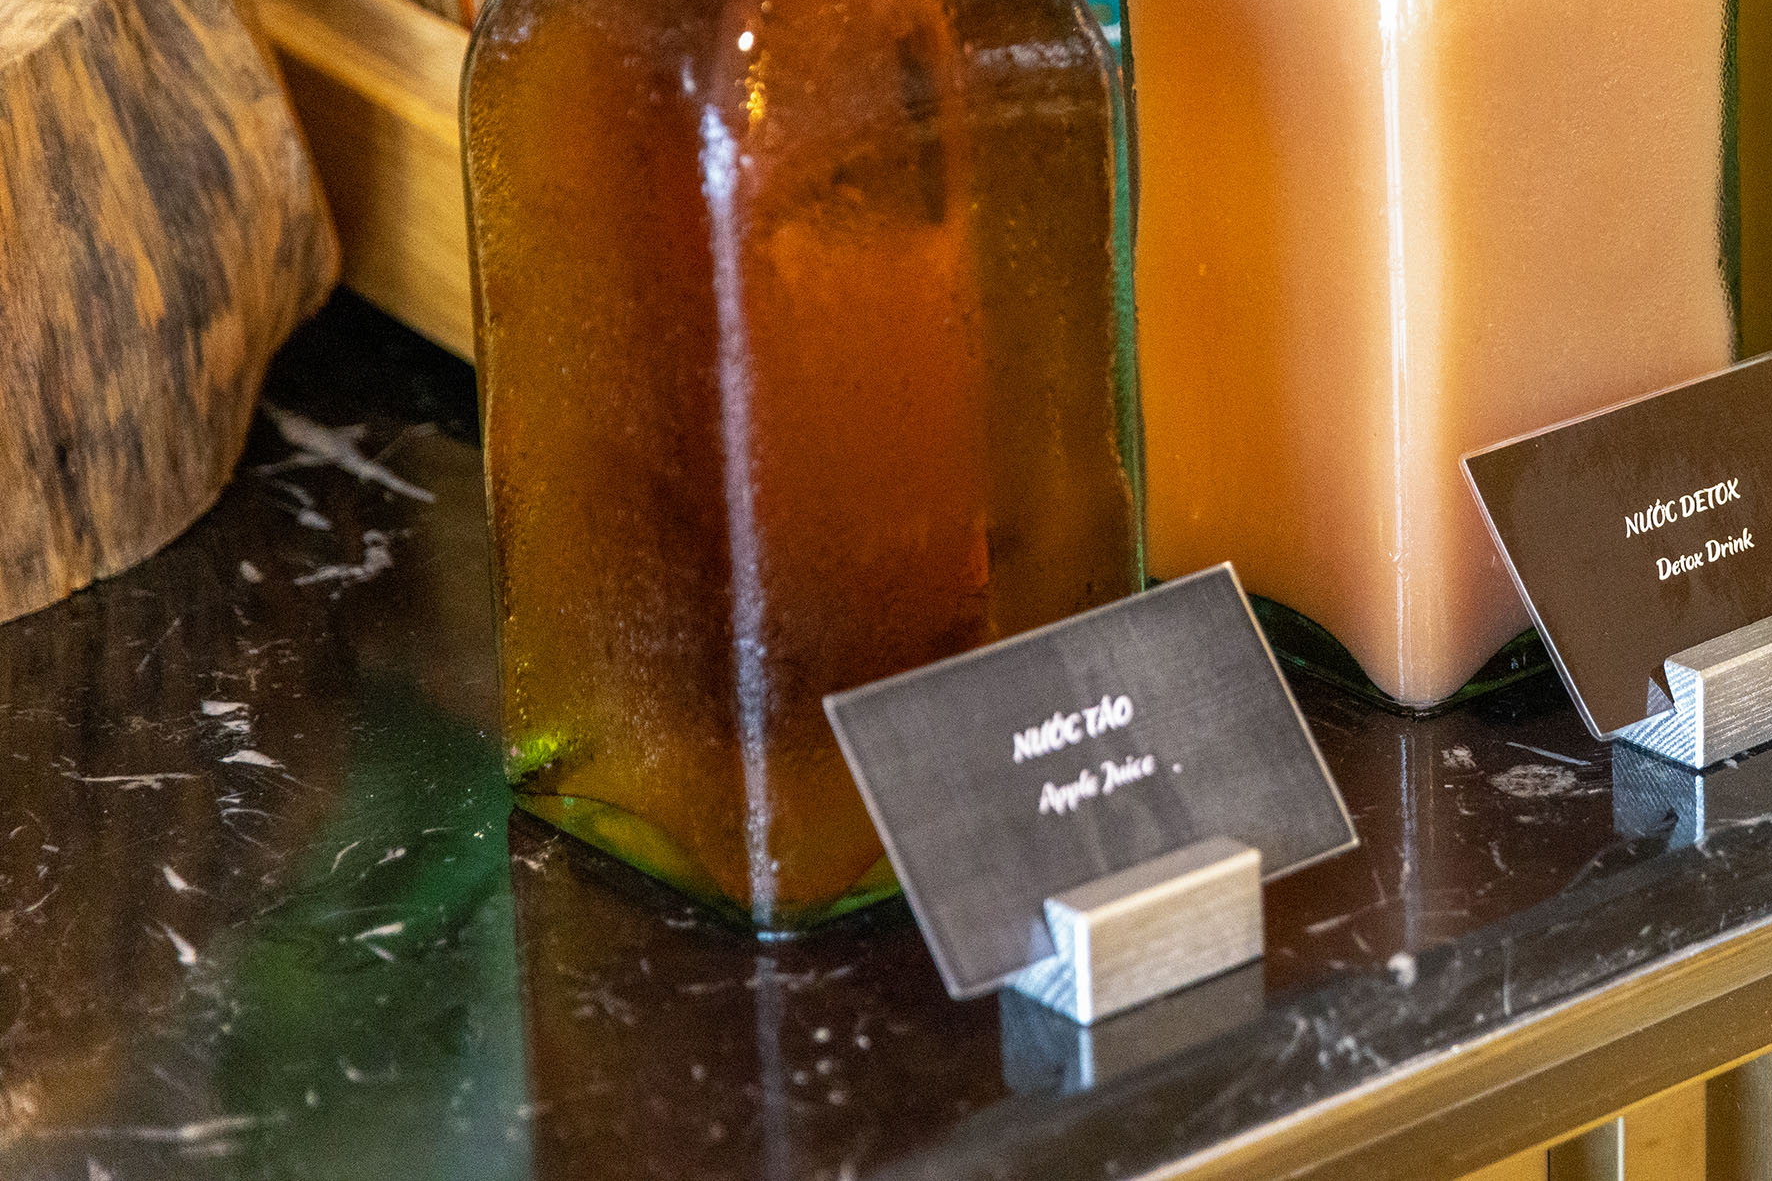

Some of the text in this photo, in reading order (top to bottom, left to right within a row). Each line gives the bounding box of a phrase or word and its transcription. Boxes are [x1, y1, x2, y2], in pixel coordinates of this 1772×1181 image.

[1624, 477, 1741, 538] NƯỚC DETOX
[1655, 527, 1755, 581] Detox Drink
[1039, 754, 1155, 815] Apple Juice
